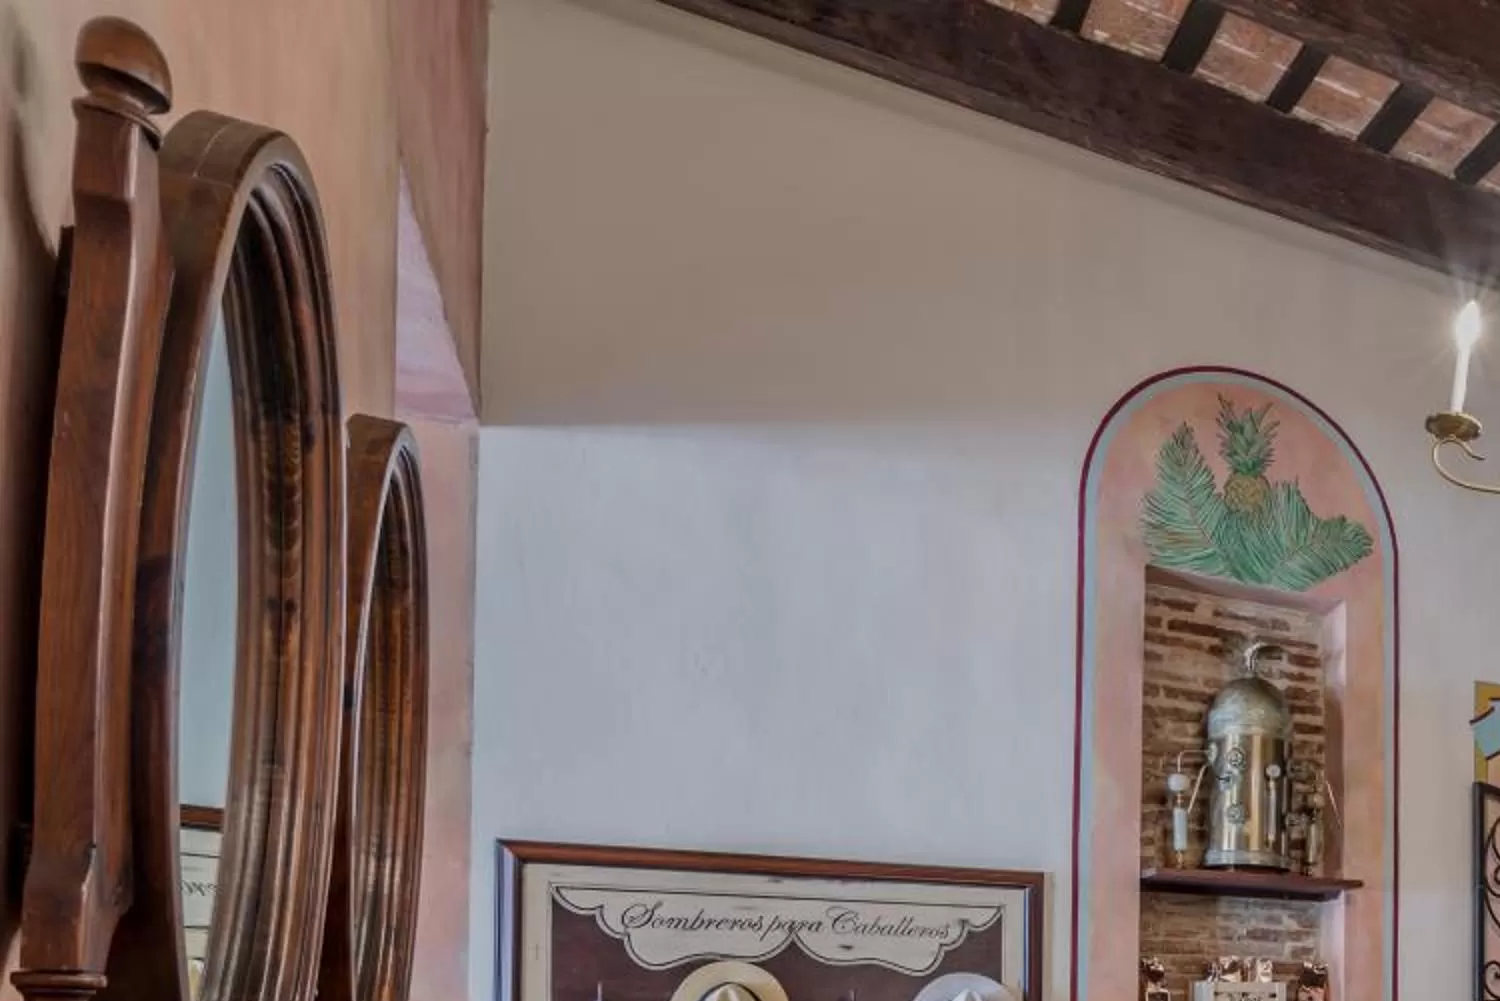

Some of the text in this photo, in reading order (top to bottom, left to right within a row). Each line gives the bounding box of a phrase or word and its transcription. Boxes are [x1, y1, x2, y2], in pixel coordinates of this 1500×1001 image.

[622, 901, 951, 942] Sombreros para Caballeros
